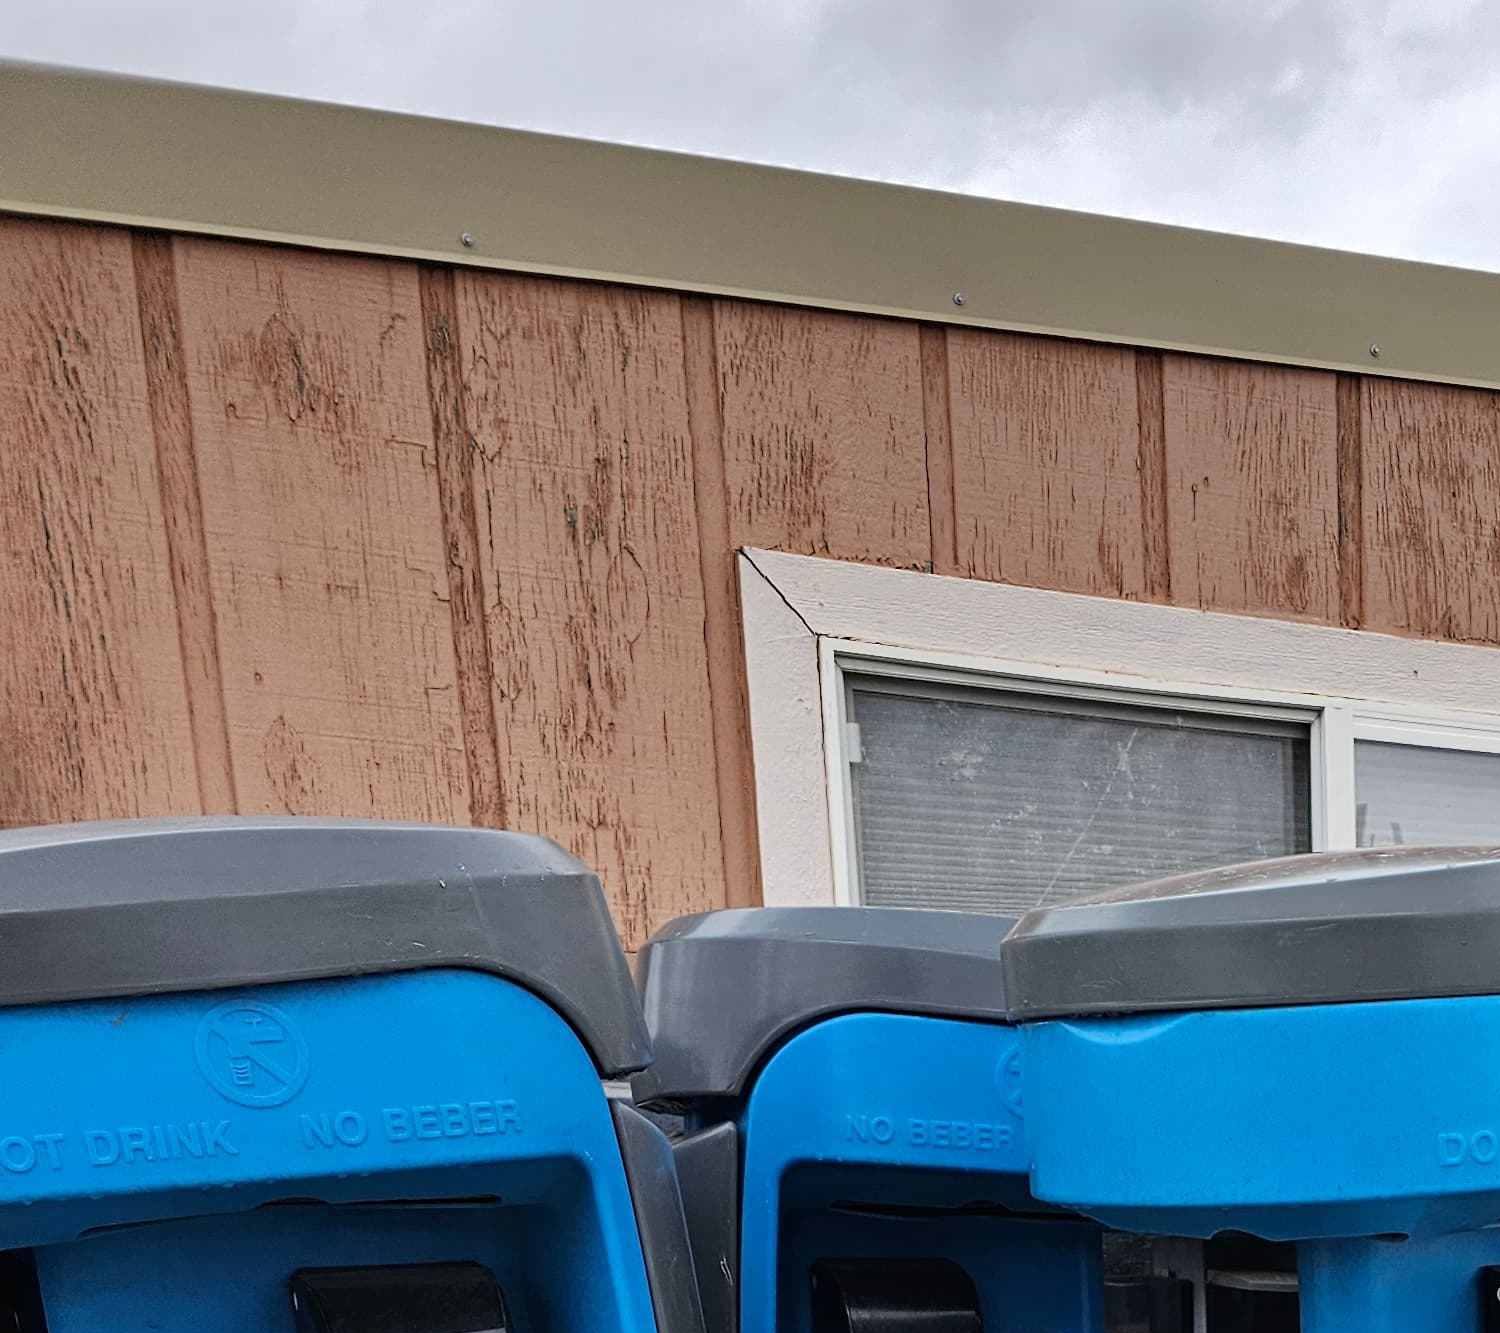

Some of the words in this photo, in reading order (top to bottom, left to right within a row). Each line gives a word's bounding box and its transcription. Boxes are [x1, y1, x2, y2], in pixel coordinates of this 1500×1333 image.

[0, 1133, 65, 1174] OT
[84, 1120, 240, 1168] DRINK
[301, 1110, 368, 1150] NO
[383, 1100, 524, 1144] BEBER
[846, 1114, 895, 1145] NO
[909, 1118, 1015, 1153] BEBER
[1438, 1129, 1497, 1168] DO
